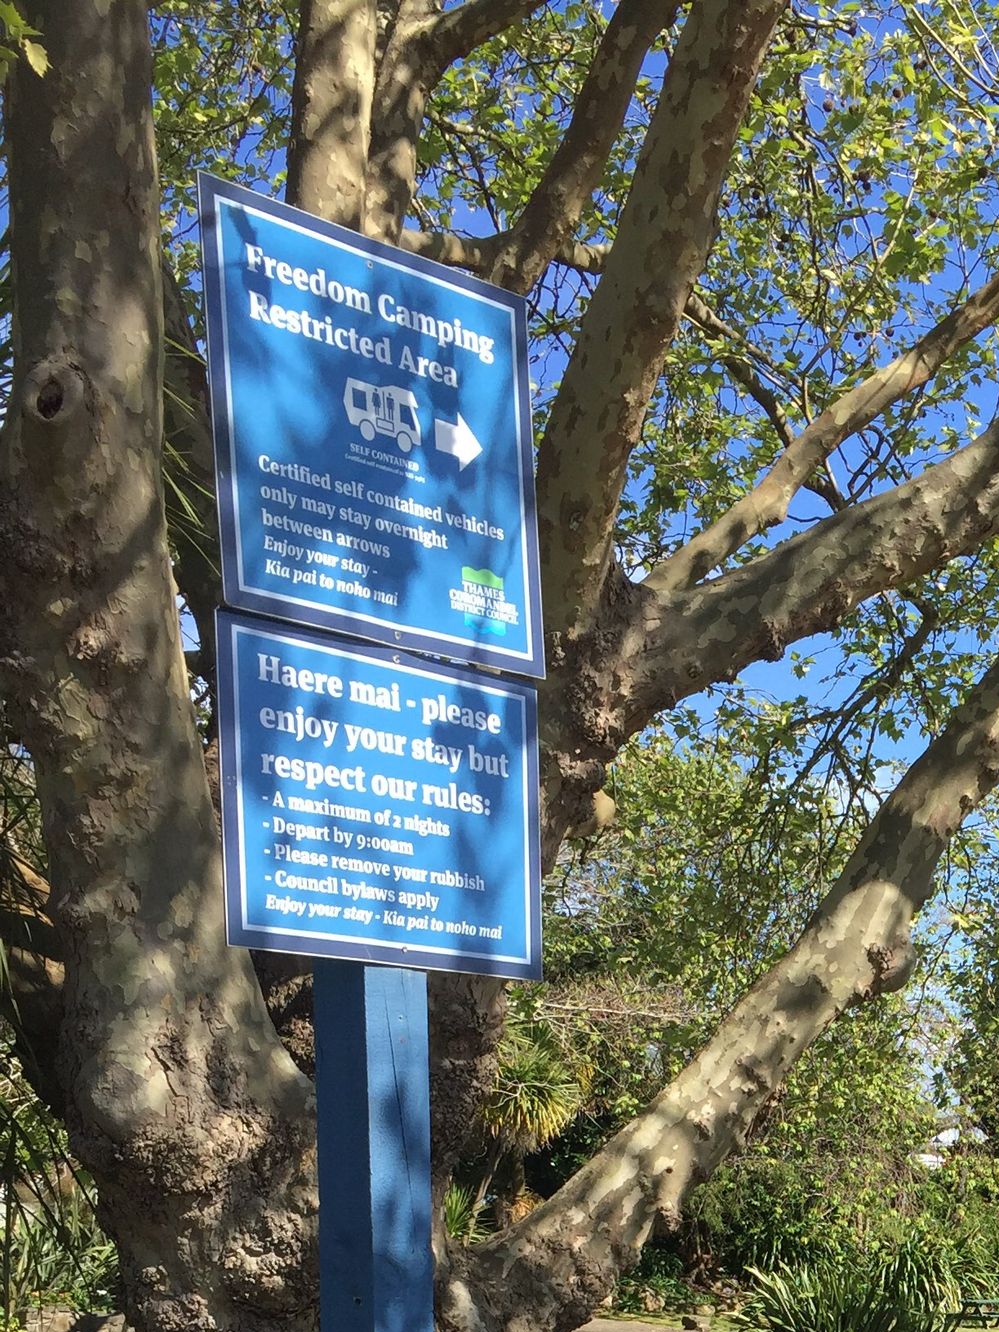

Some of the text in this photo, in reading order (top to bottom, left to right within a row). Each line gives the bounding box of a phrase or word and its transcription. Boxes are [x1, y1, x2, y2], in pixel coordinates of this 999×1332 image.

[245, 242, 495, 365] Freedom Camping
[249, 289, 459, 389] Restricted Area
[350, 442, 370, 456] SELF
[258, 455, 505, 541] Certified self contained vehicles
[260, 485, 448, 549] only may stay overnight
[261, 507, 391, 558] between arrows
[264, 535, 304, 560] Enjoy
[306, 548, 339, 567] your
[340, 557, 370, 578] stay
[265, 558, 398, 607] Kia pai to noho mai
[462, 580, 505, 601] THAMES
[257, 653, 343, 698] Haere
[349, 679, 402, 713] mai
[421, 694, 502, 735] please
[259, 705, 509, 778] enjoy your stay but
[261, 753, 491, 817] respect our rules:
[272, 790, 285, 808] A
[287, 796, 372, 823] maximum
[373, 808, 392, 826] of
[392, 815, 402, 829] 2
[403, 814, 450, 837] nights
[272, 816, 330, 842] Depart
[333, 826, 353, 848] by
[356, 834, 414, 856] 9:00am
[274, 843, 328, 867] Please
[331, 855, 390, 876] remove
[393, 865, 428, 883] your
[430, 870, 485, 892] rubbish
[274, 870, 339, 895] Council
[341, 878, 396, 902] bylaws
[398, 890, 440, 912] apply
[265, 894, 307, 916] Enjoy
[308, 902, 342, 918] your
[343, 906, 373, 925] stay
[383, 910, 405, 927] Kia
[406, 915, 429, 931] pai
[430, 917, 444, 932] to
[445, 921, 477, 937] noho
[478, 925, 503, 940] mai
